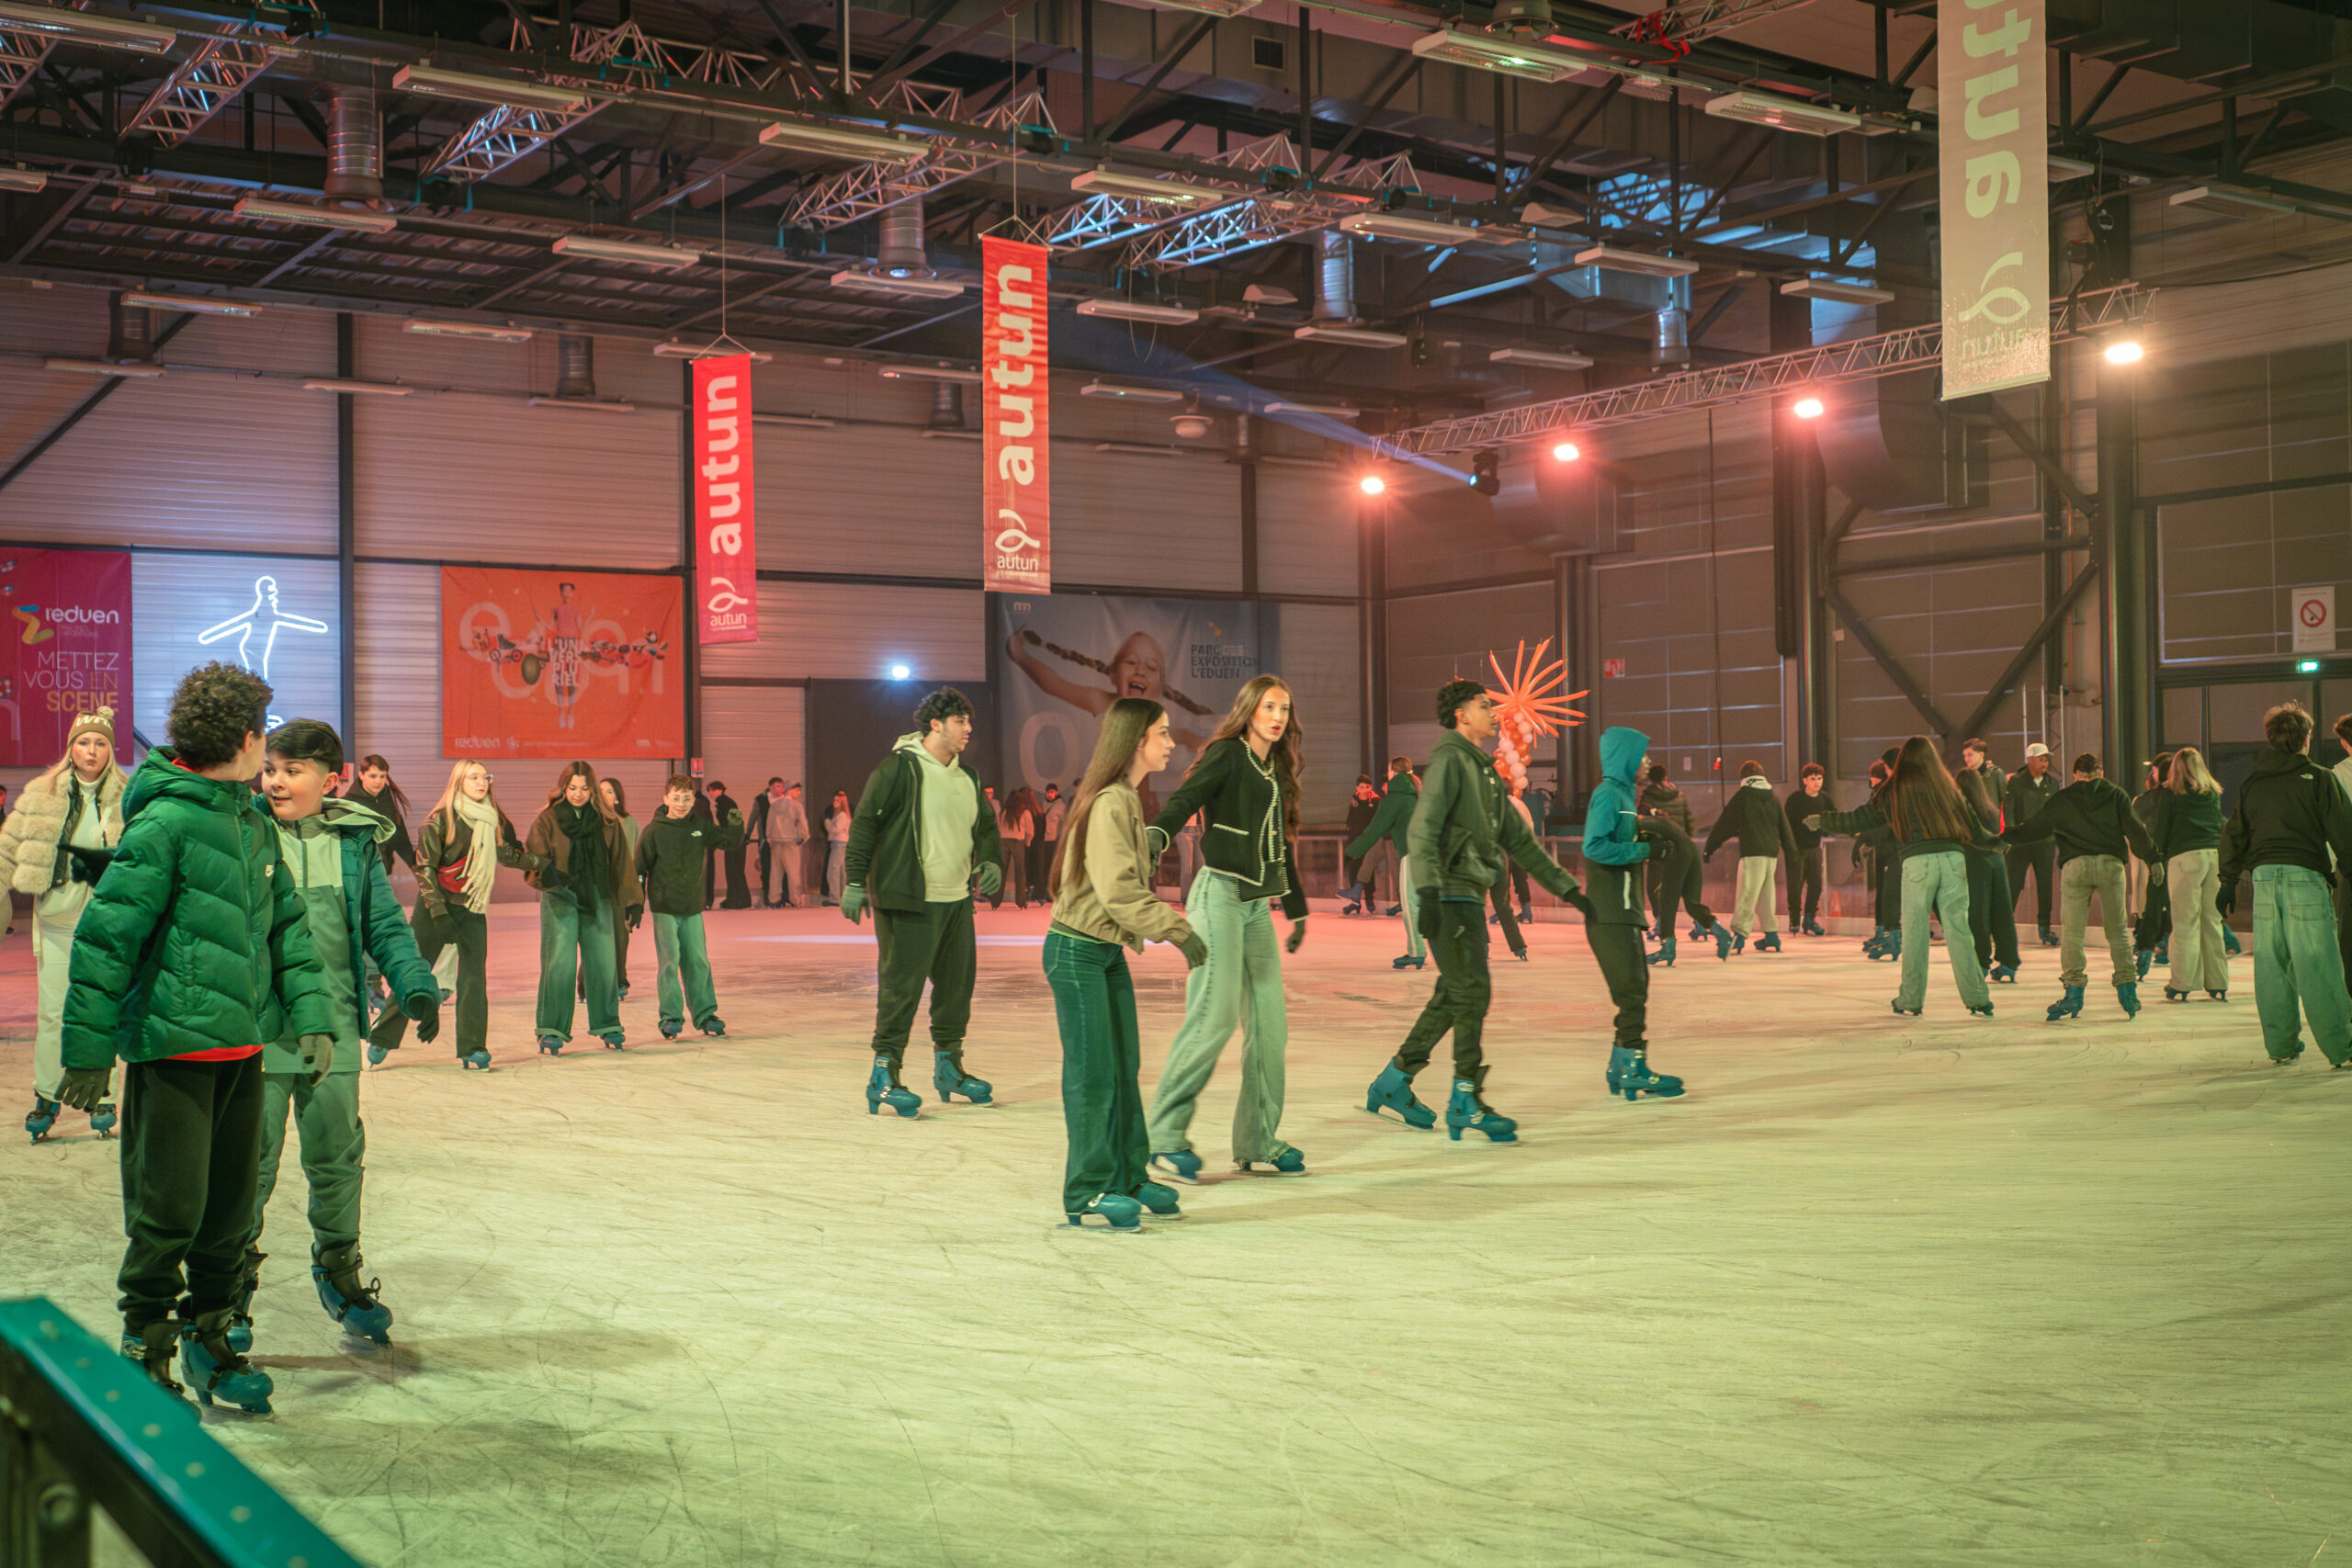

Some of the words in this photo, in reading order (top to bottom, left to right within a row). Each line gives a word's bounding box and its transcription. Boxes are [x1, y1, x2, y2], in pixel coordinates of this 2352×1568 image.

[991, 264, 1035, 486] autun
[702, 375, 742, 557] autun
[997, 554, 1039, 571] autun
[709, 613, 747, 626] autun
[1191, 644, 1223, 656] PARC
[38, 650, 119, 671] METTEZ
[23, 671, 84, 689] VOUS
[90, 671, 119, 690] EN
[1191, 667, 1240, 679] L'EDUEN
